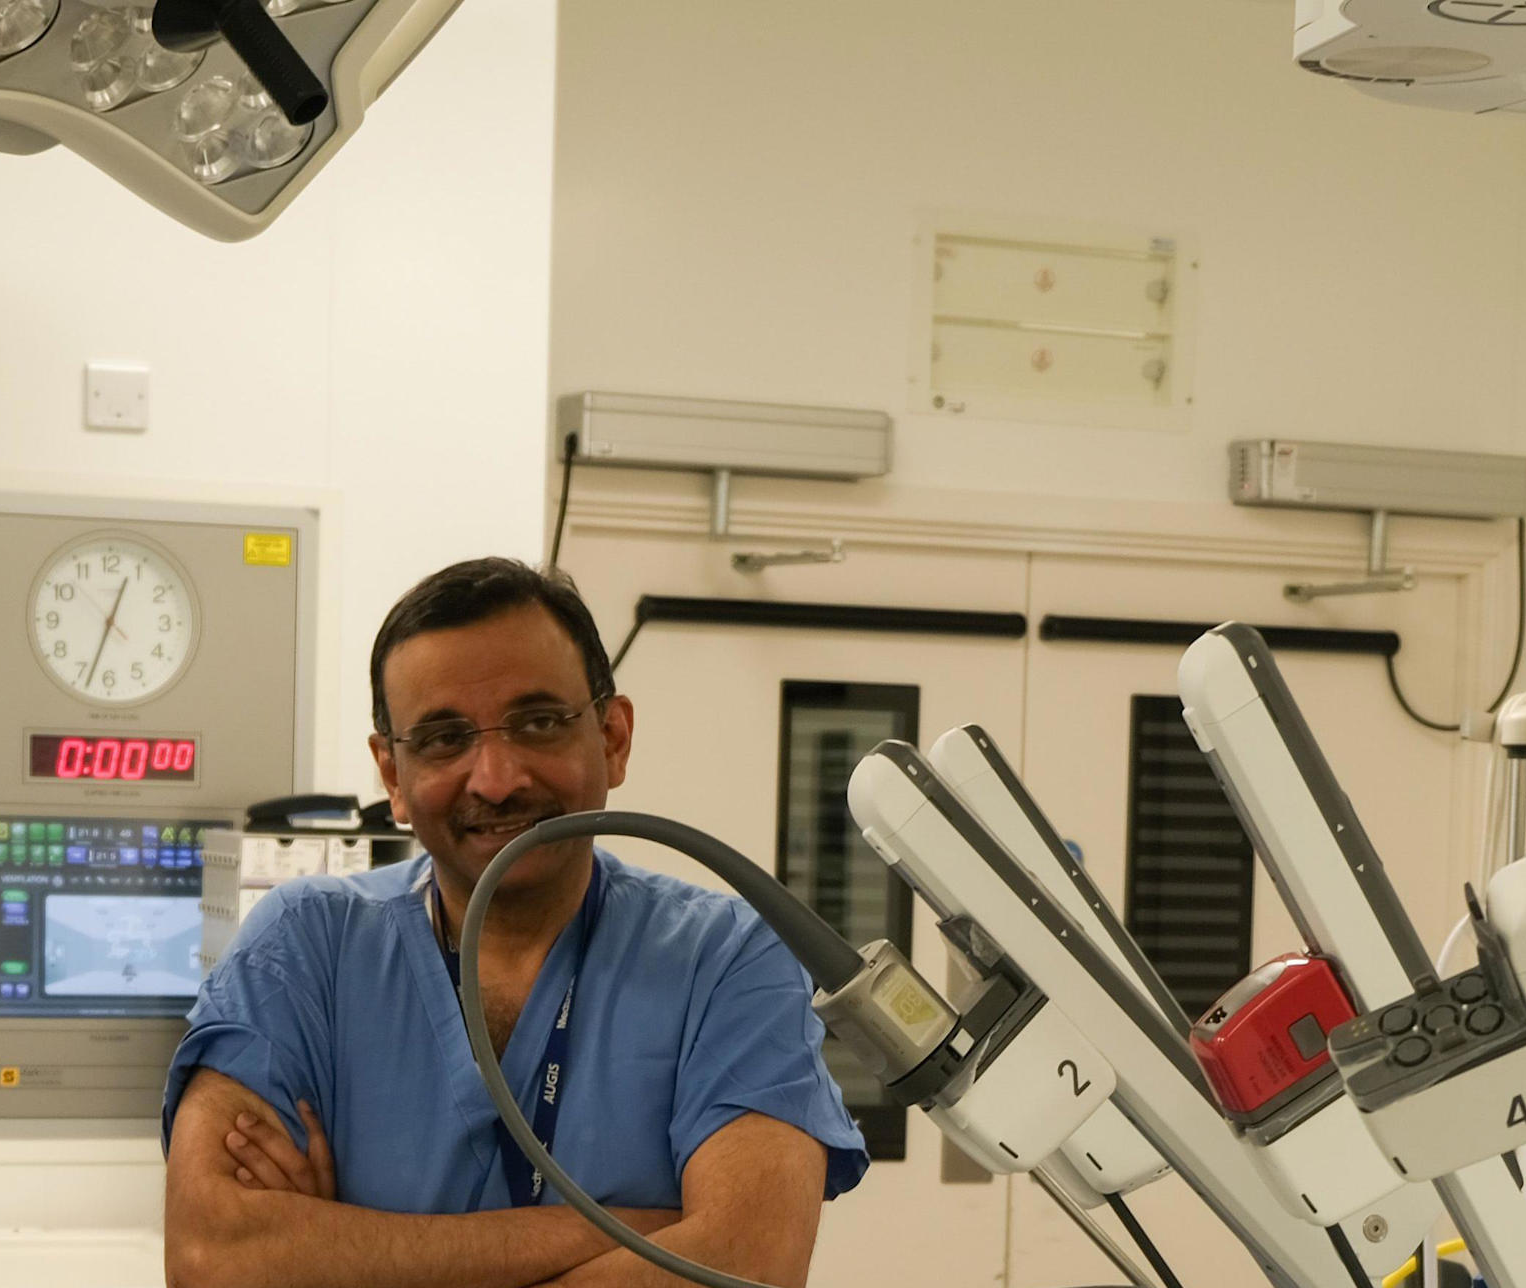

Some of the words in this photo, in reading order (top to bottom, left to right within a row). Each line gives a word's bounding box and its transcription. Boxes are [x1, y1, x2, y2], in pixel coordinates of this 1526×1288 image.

[76, 562, 89, 580] 11
[102, 555, 120, 573] 12
[135, 564, 141, 581] 1
[54, 583, 74, 601] 10
[153, 585, 166, 603] 2
[46, 611, 60, 629] 9
[158, 614, 171, 632] 3
[54, 640, 67, 658] 8
[151, 643, 164, 659] 4
[75, 661, 87, 679] 7
[102, 670, 115, 687] 6
[130, 661, 143, 680] 5
[543, 1062, 560, 1105] AUGIS
[1058, 1060, 1091, 1097] 2
